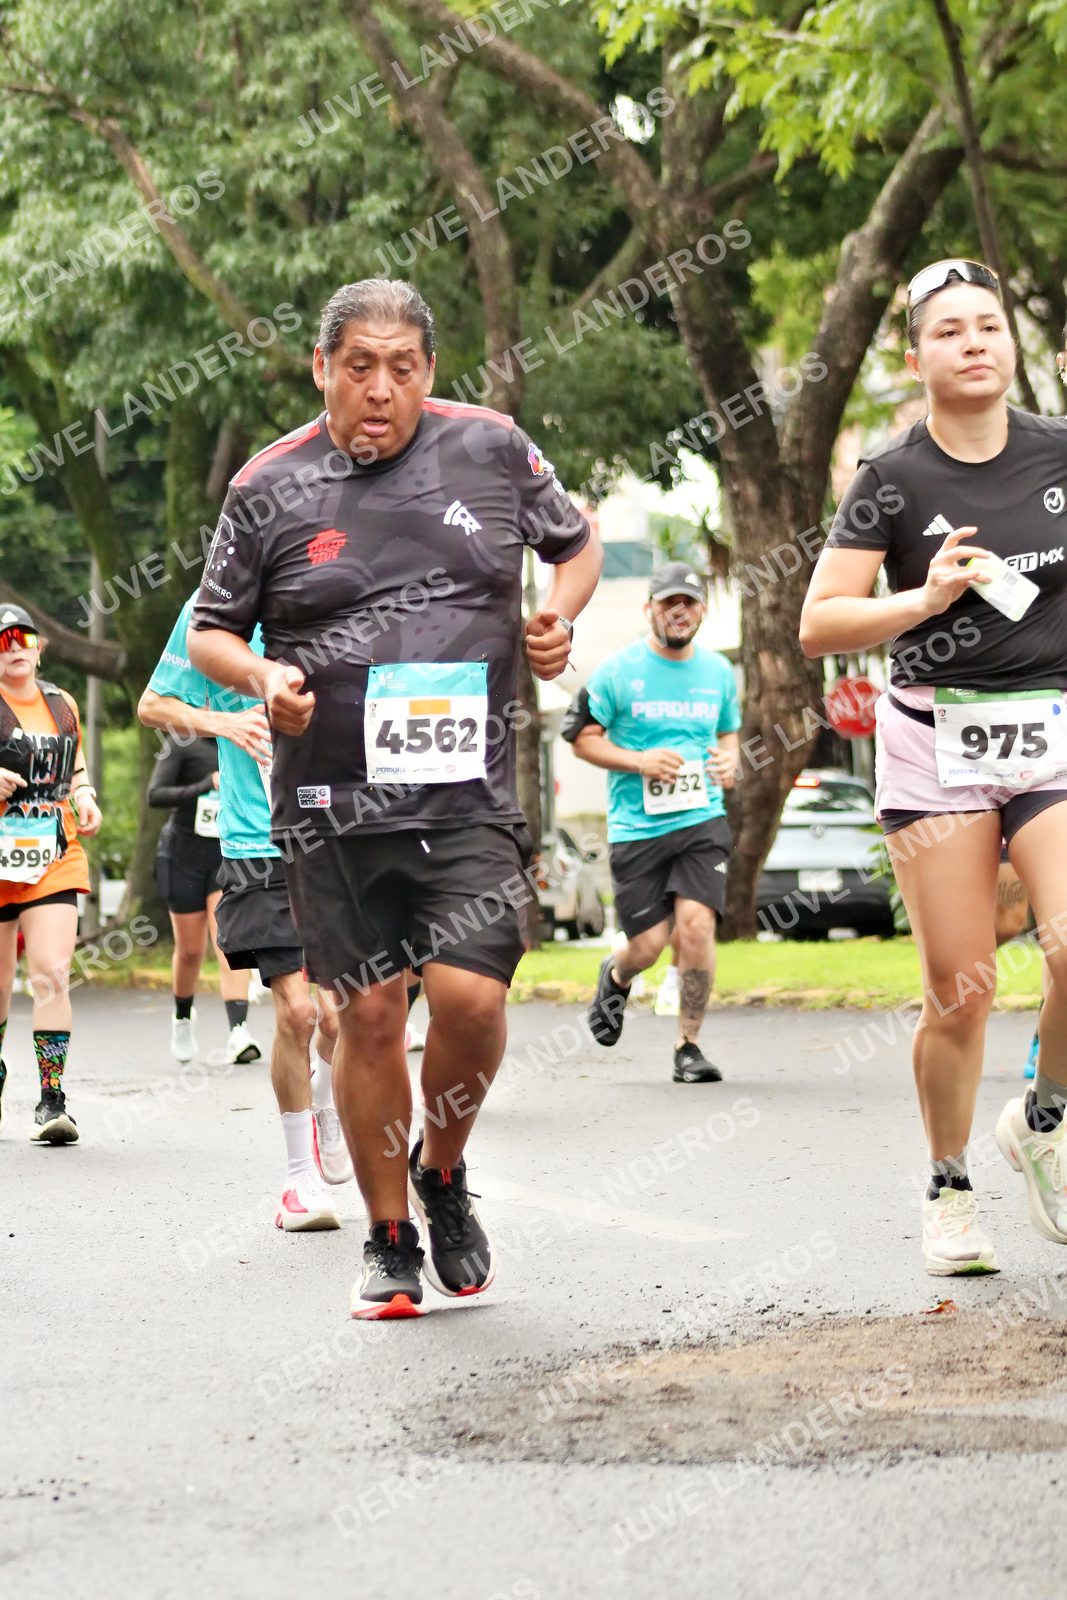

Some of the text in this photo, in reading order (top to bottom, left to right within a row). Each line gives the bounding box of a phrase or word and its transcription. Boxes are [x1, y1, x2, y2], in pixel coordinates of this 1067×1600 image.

[1039, 546, 1065, 568] MX
[208, 578, 233, 600] QUATRO
[631, 700, 720, 720] PERDURA
[375, 717, 478, 755] 4562
[960, 722, 1049, 761] 975
